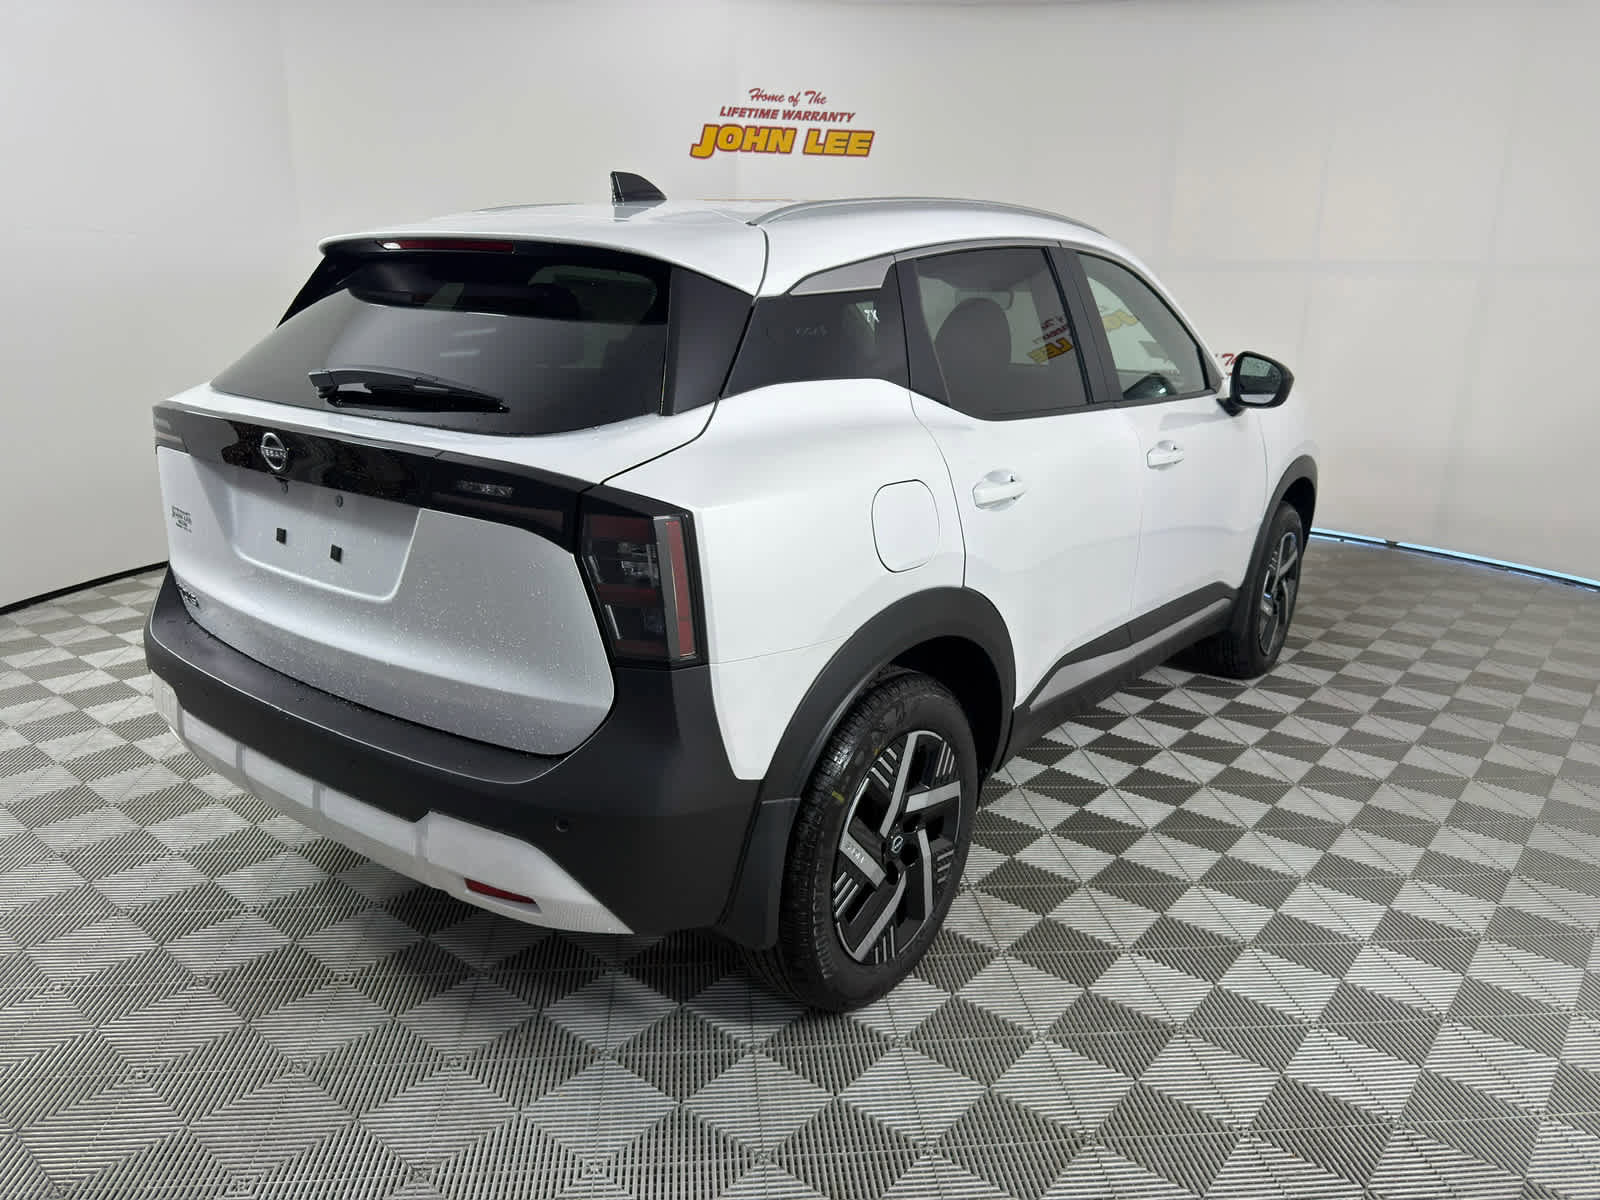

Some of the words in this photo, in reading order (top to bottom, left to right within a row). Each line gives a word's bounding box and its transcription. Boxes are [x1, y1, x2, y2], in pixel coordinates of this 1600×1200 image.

[749, 88, 785, 102] Home
[788, 92, 801, 106] of
[804, 91, 827, 105] The
[720, 106, 778, 119] LIFETIME
[782, 110, 855, 122] WARRANTY
[690, 124, 797, 159] JOHN
[802, 128, 875, 157] LEE
